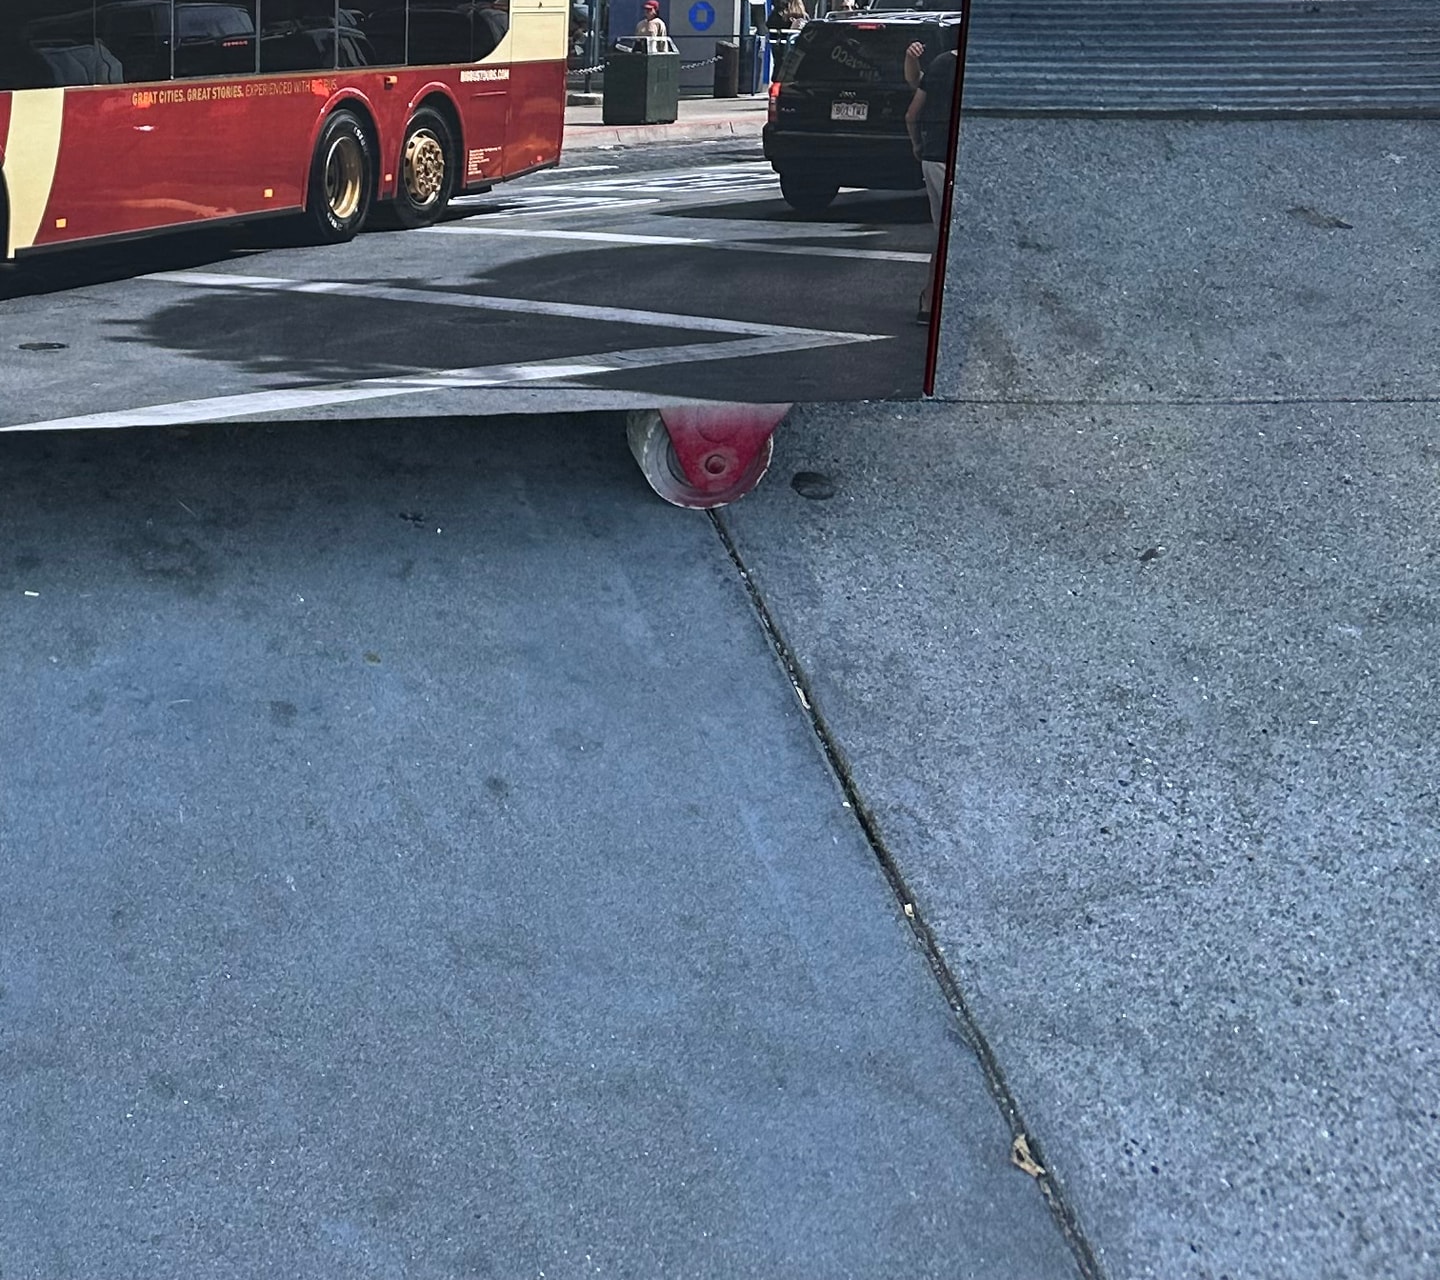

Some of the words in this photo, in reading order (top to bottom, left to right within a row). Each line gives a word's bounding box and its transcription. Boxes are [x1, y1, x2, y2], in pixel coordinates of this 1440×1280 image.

[131, 91, 158, 107] GREAT
[159, 90, 186, 104] CITIES.
[187, 88, 212, 102] GREAT
[212, 85, 245, 100] STORIES.
[245, 81, 293, 97] EXPERIENCED
[293, 80, 311, 94] WITH
